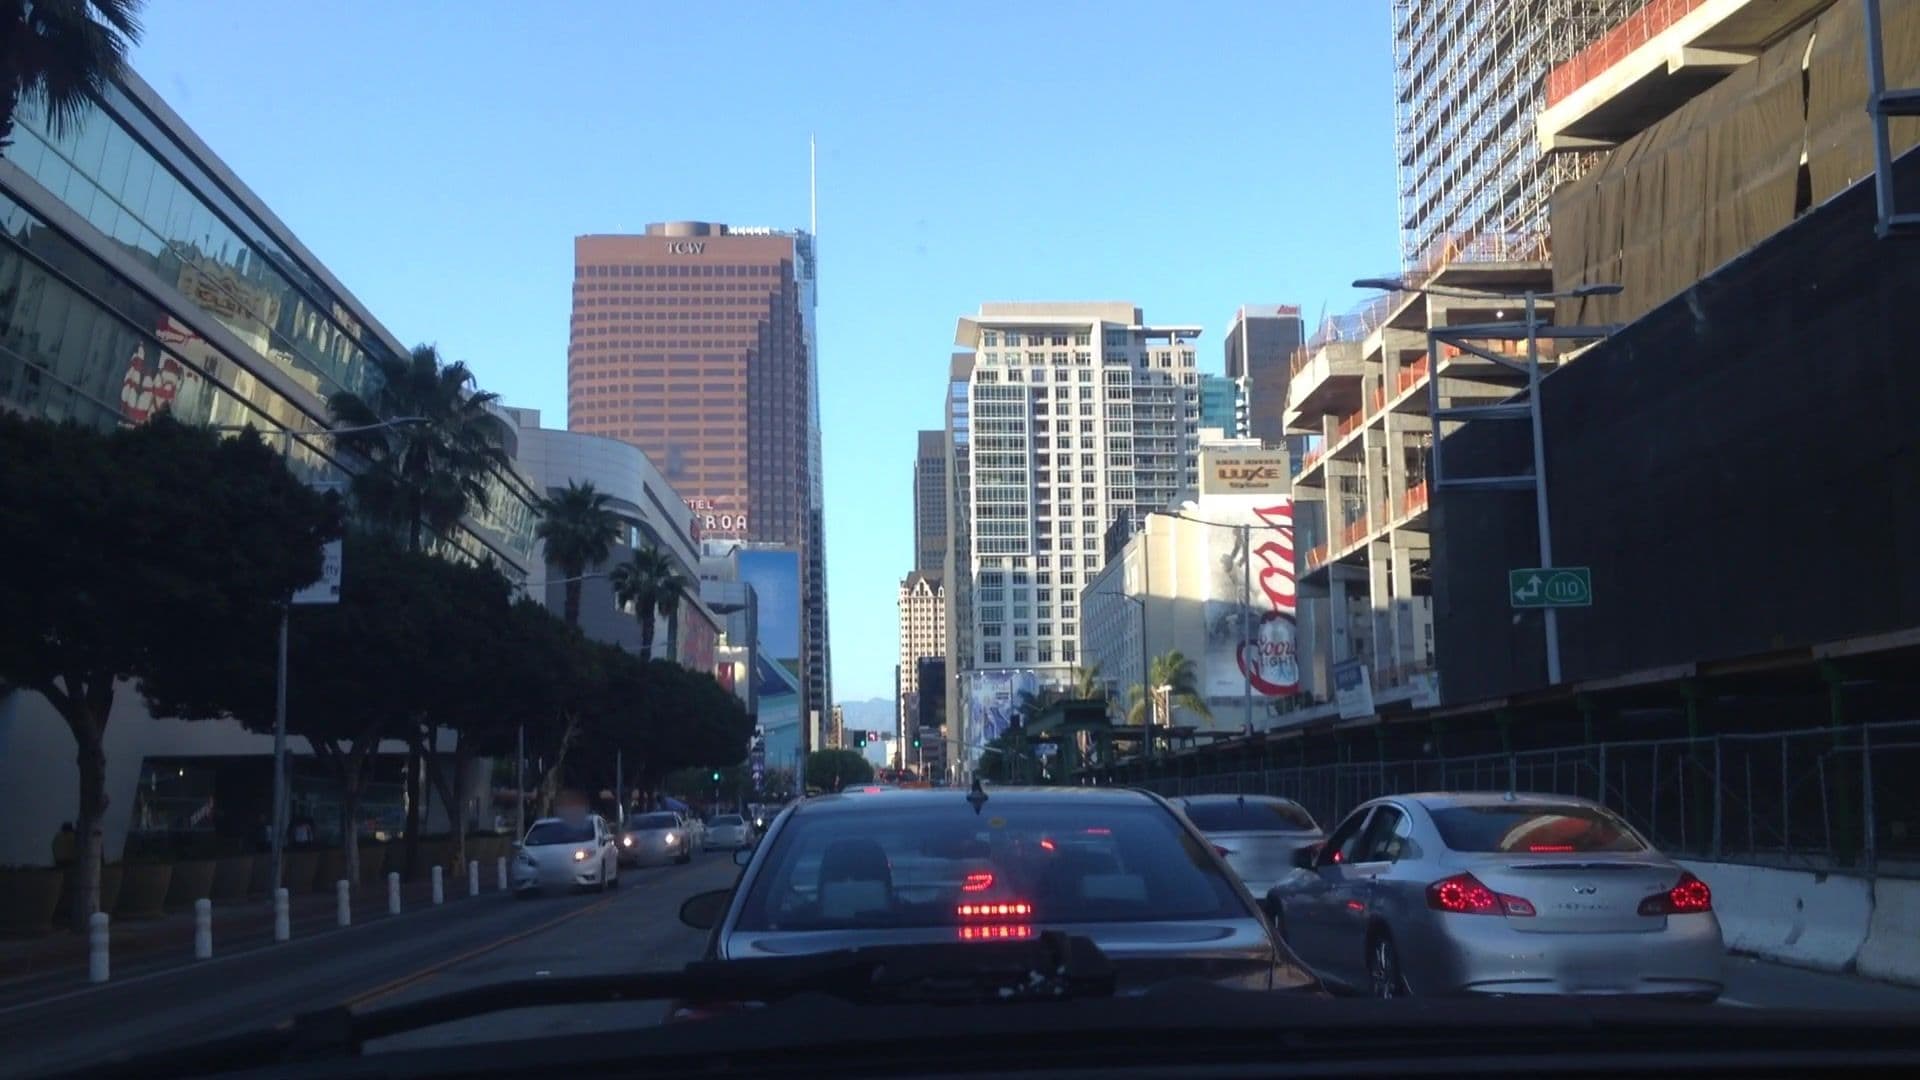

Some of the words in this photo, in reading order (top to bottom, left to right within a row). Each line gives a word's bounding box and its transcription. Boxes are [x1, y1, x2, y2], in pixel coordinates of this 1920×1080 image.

[667, 242, 705, 254] TCW
[1218, 466, 1281, 481] LUXE
[682, 499, 714, 509] TEL
[1555, 581, 1579, 596] 110
